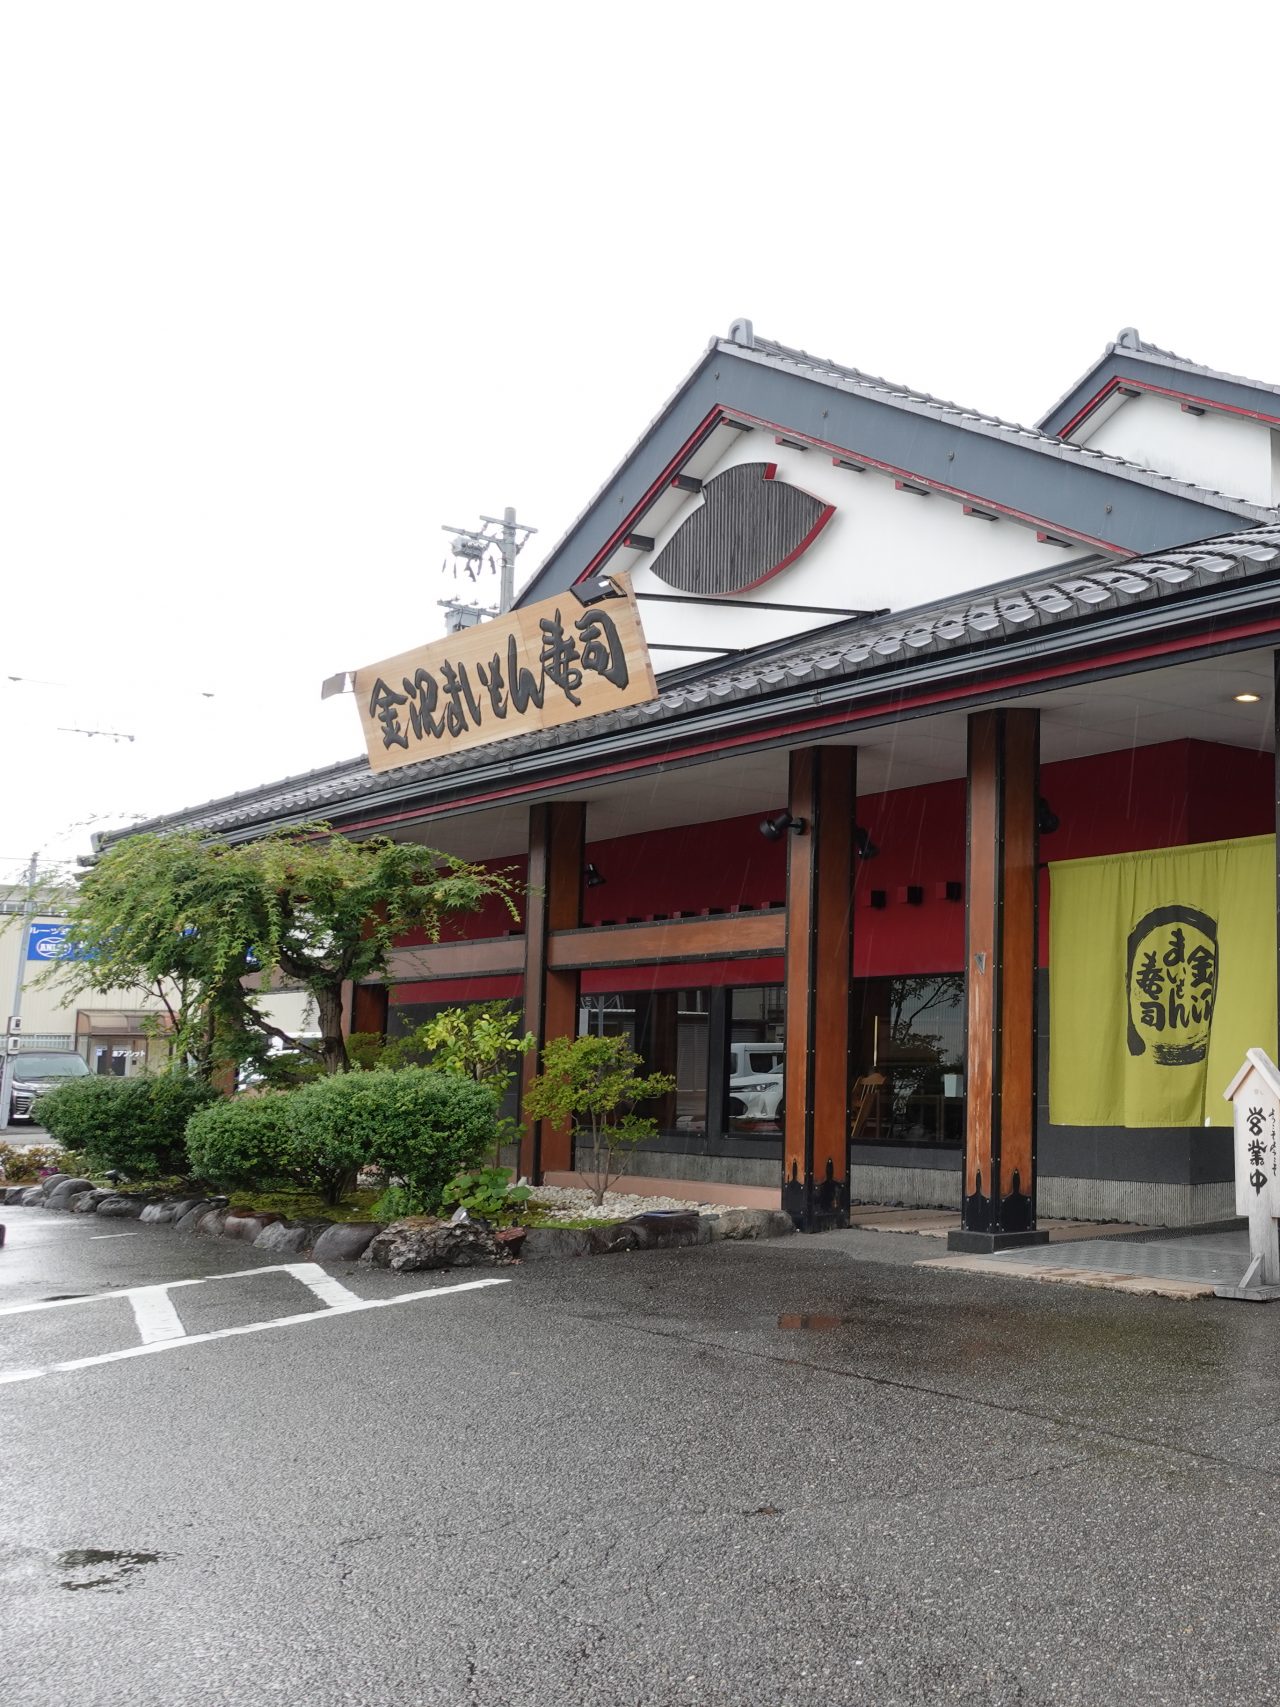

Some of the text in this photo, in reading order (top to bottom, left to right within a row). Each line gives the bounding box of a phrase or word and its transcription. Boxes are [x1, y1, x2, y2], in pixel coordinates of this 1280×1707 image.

[368, 607, 629, 751] 金沢まいもん寿司
[1135, 949, 1166, 1032] 寿司
[1162, 927, 1191, 1030] まいもん
[1246, 1105, 1268, 1197] 営業中
